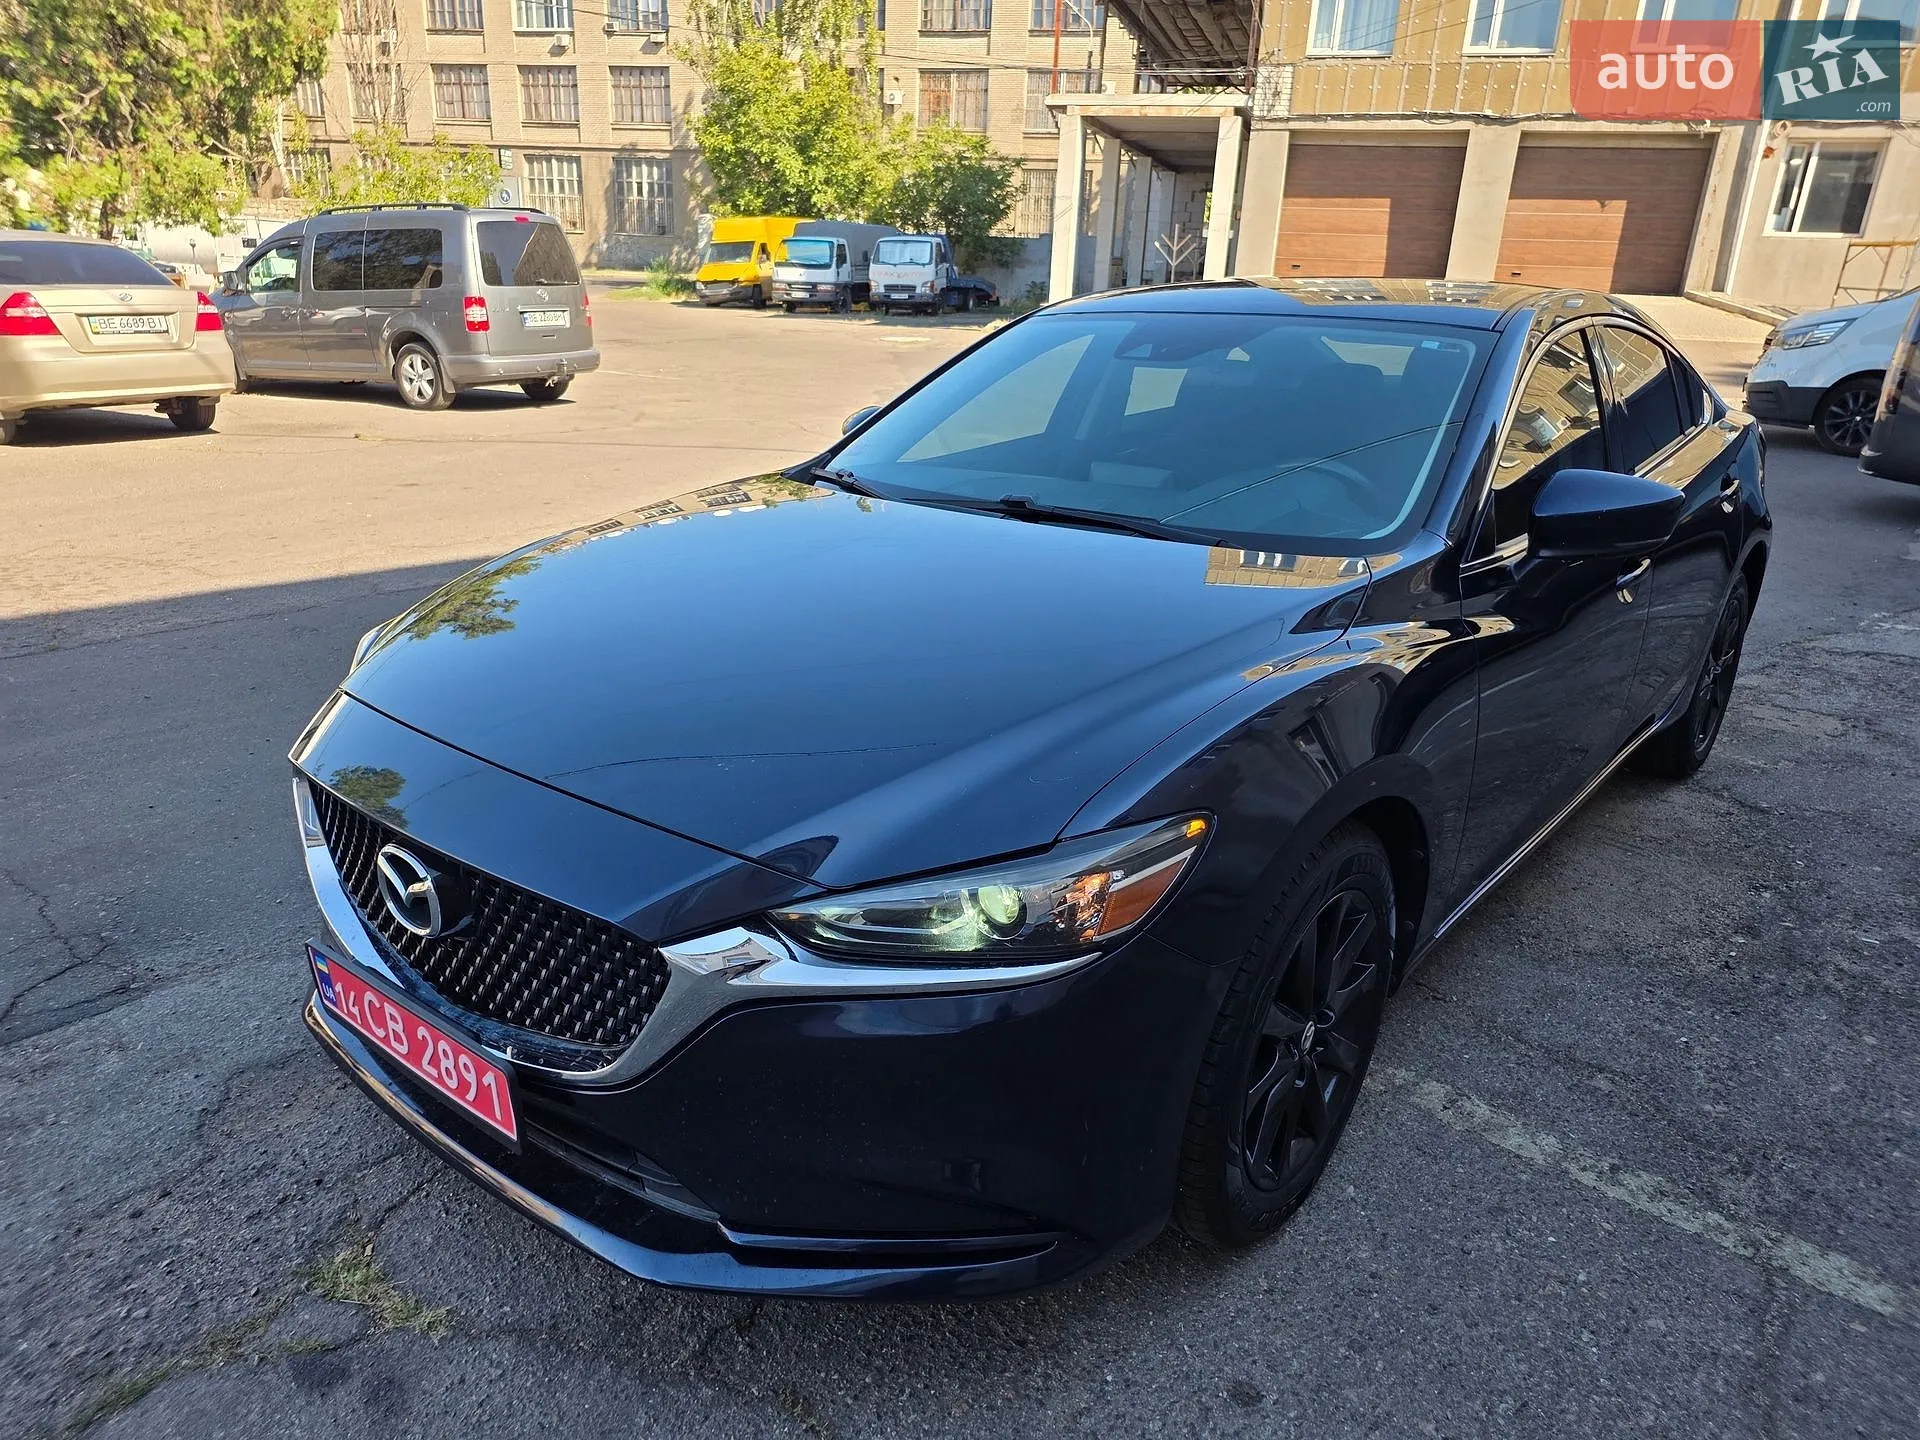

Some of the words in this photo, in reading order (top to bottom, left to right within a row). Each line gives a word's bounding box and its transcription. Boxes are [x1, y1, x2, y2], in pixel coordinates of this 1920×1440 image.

[98, 317, 117, 330] BE
[119, 317, 145, 329] 6689
[322, 982, 337, 1002] UA
[416, 1026, 503, 1121] 2891
